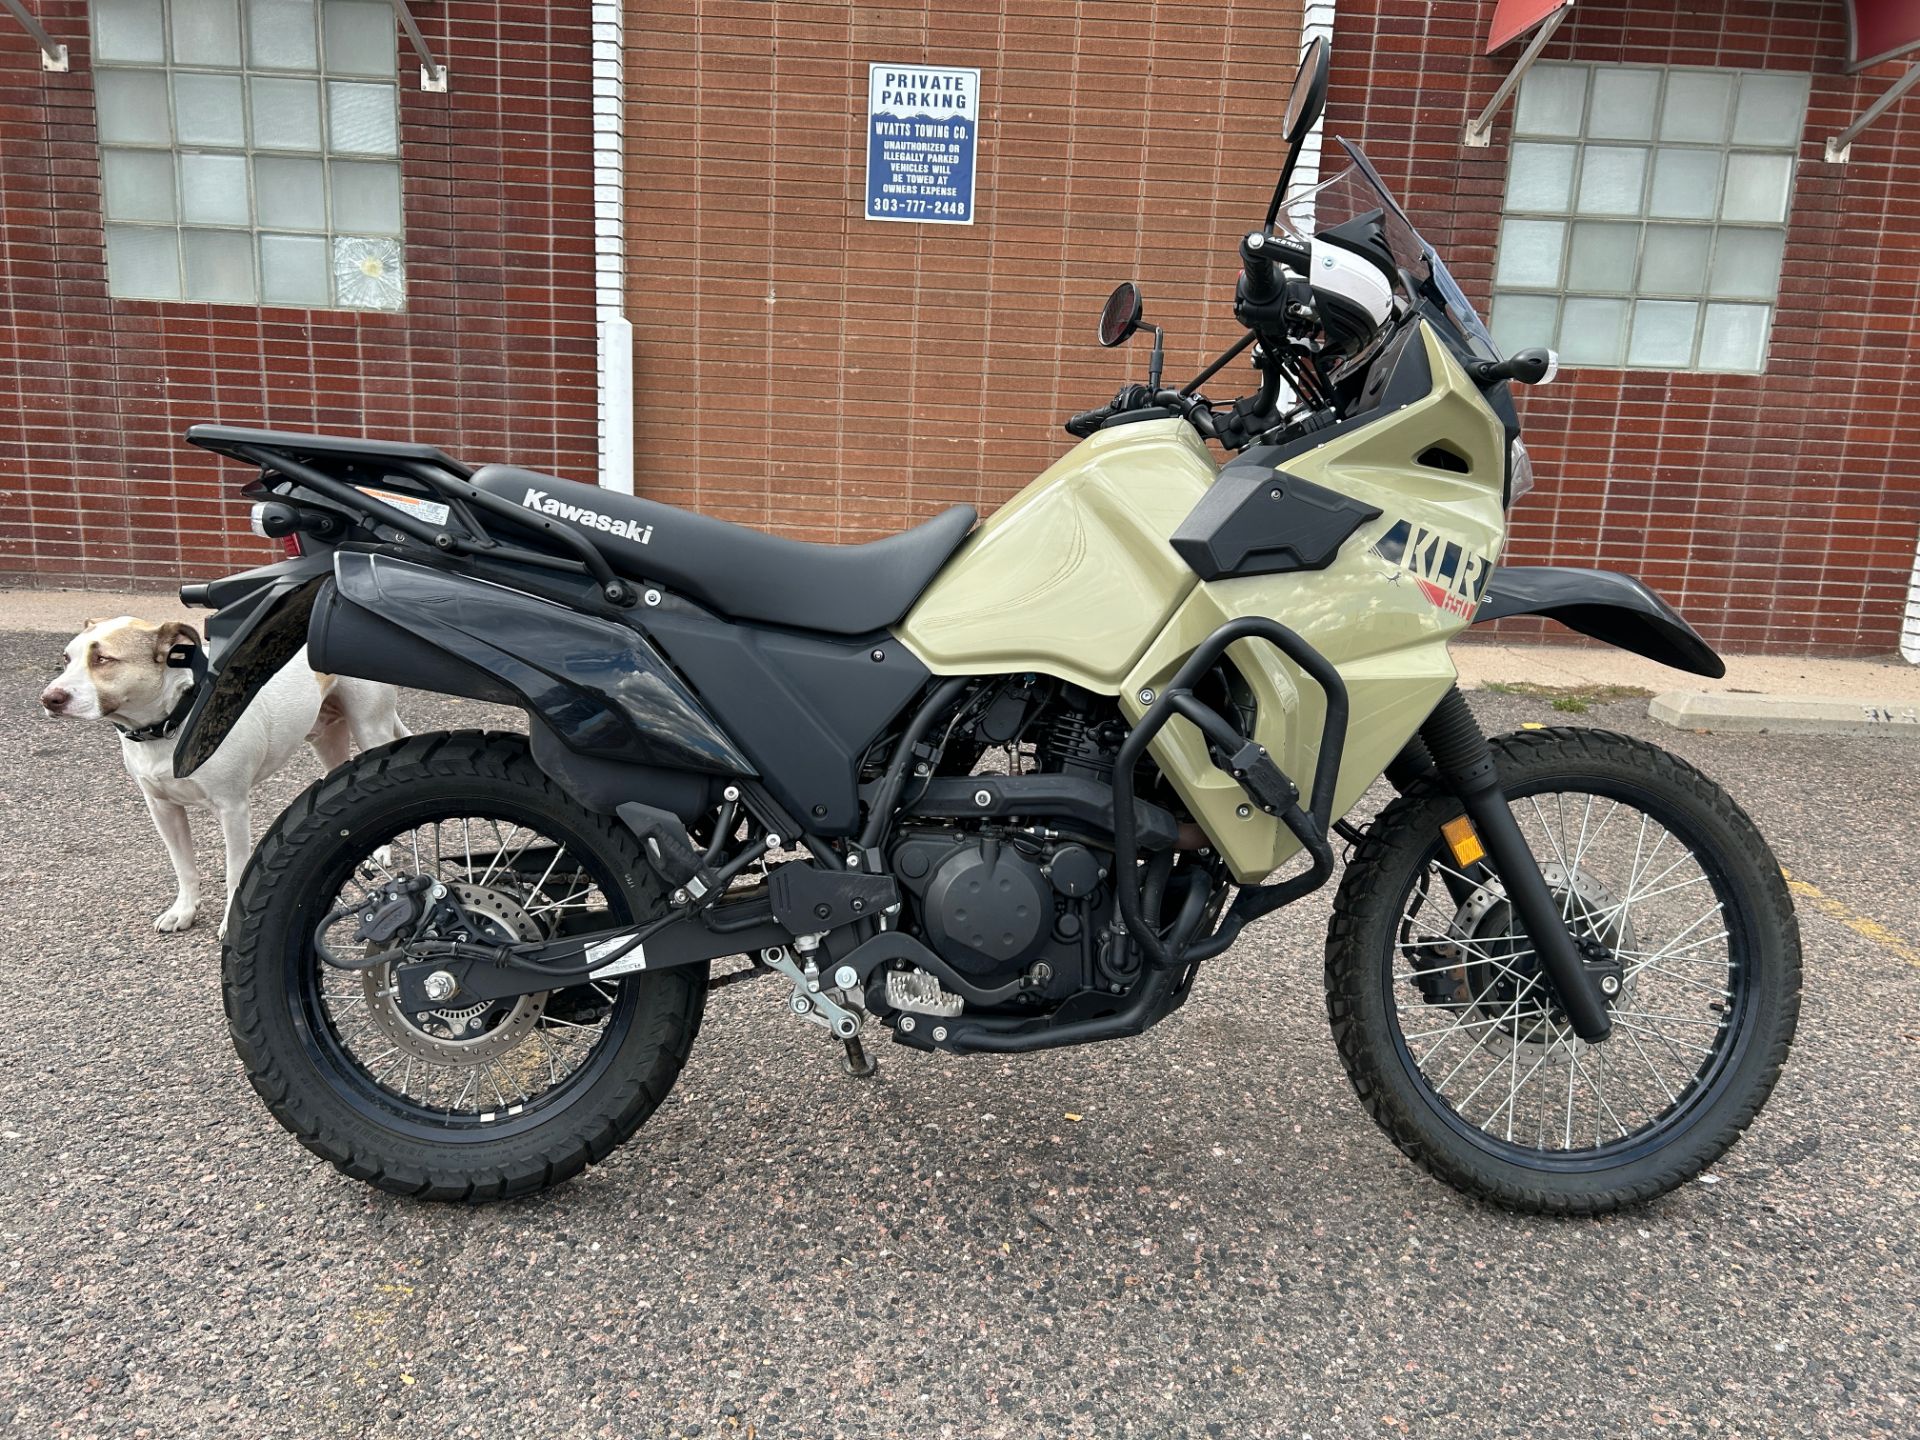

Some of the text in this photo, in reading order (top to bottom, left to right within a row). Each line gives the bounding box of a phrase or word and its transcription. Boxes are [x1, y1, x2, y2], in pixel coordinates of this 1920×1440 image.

[885, 73, 964, 91] PRIVATE
[881, 90, 966, 109] PARKING
[875, 121, 969, 140] WYATTS TOWING CO.
[883, 140, 960, 153] UNAUTHORIZED OR
[883, 151, 960, 164] ILLEGALLY PARKED
[890, 163, 951, 175] VEHICLES WILL
[892, 173, 949, 185] BE TOWED AT
[882, 184, 957, 197] OWNERS EXPENSE
[873, 197, 965, 215] 303-777-2448
[522, 488, 654, 545] Kawasaki
[1396, 522, 1485, 604] KLR
[1441, 592, 1475, 620] 650
